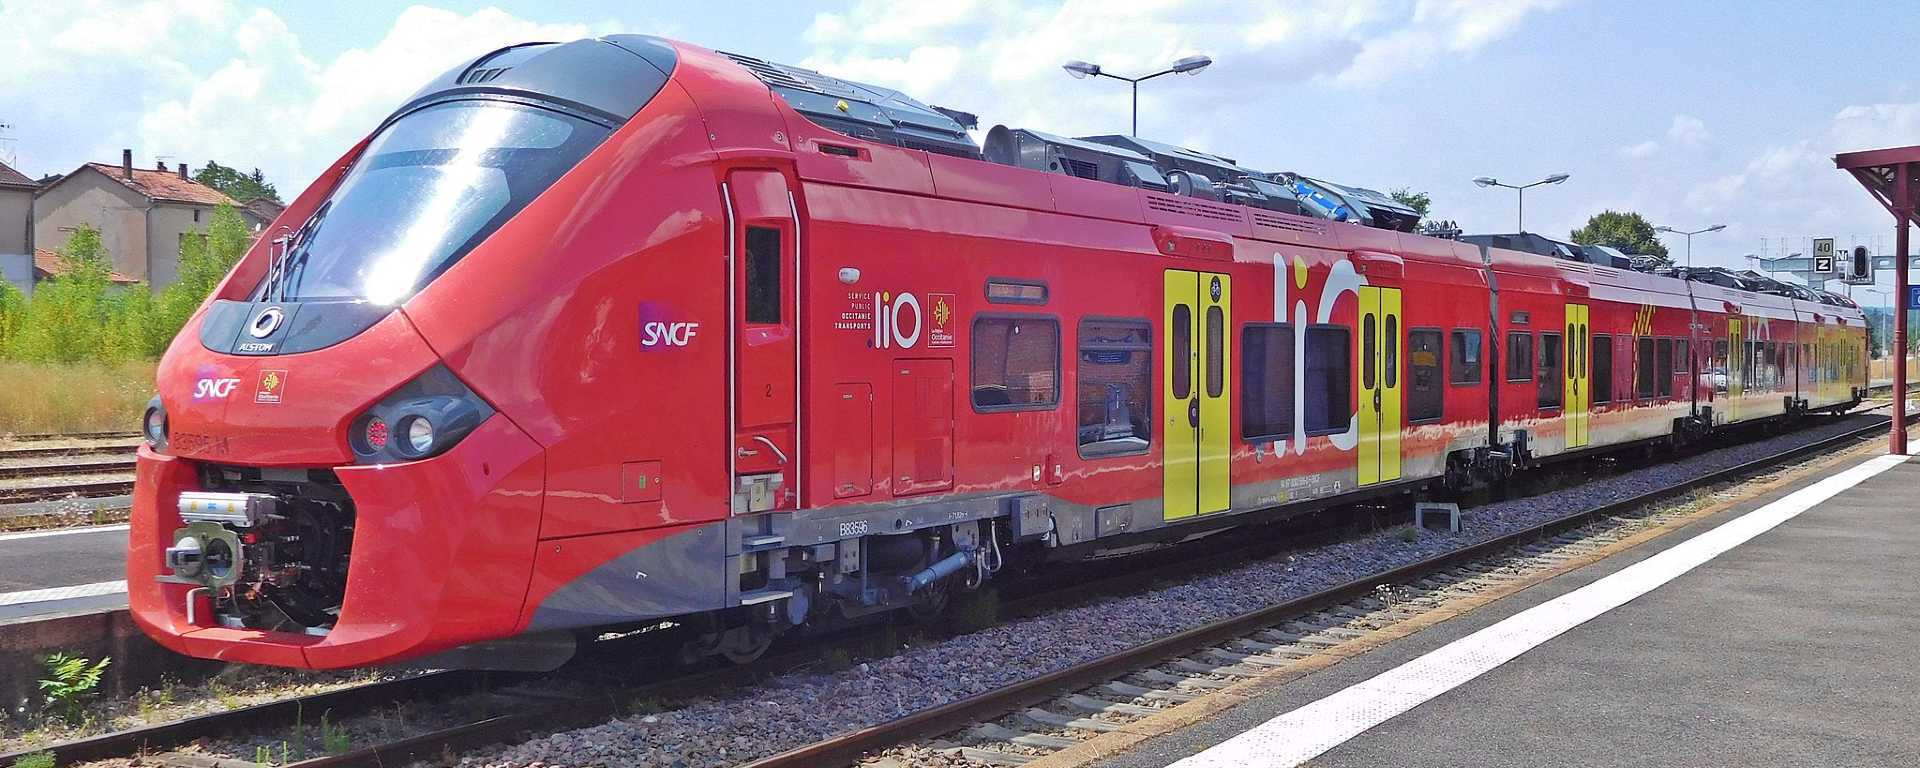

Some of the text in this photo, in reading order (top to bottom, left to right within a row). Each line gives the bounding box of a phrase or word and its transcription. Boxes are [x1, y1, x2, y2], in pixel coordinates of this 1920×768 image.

[1817, 242, 1830, 252] 40
[1818, 259, 1829, 270] Z
[641, 322, 699, 346] SNCF
[239, 343, 273, 352] ALSTOM
[194, 378, 240, 398] SNCF
[766, 384, 771, 397] 2
[840, 520, 868, 536] B83596
